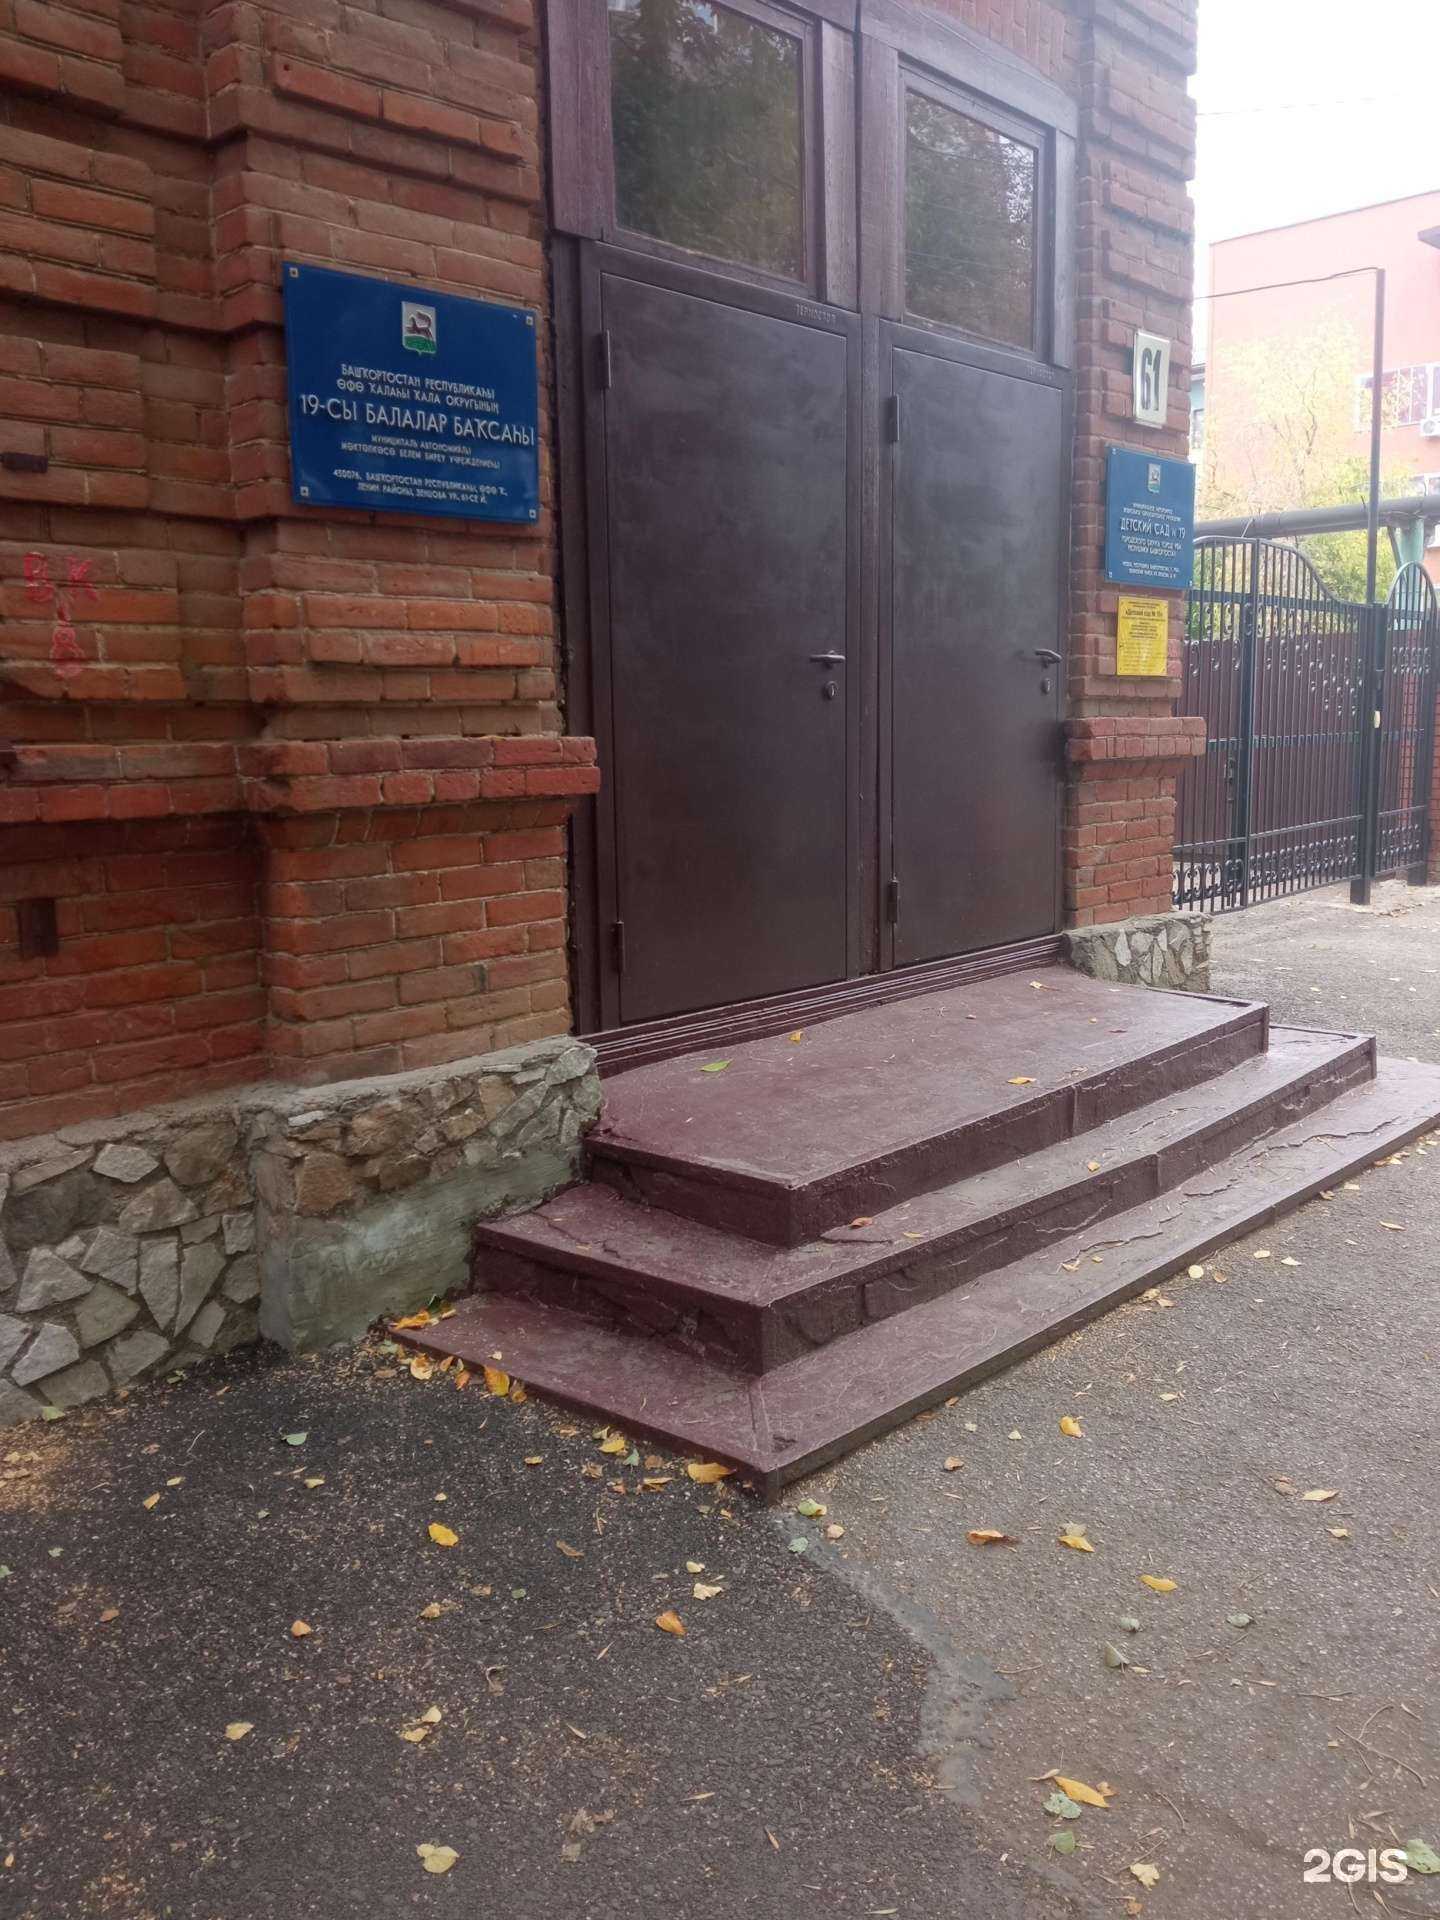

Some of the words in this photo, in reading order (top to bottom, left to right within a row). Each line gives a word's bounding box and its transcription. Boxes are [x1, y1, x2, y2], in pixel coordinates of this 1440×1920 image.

[336, 379, 365, 393] ӨФӨ
[413, 390, 441, 405] ҠАЛА
[1140, 347, 1163, 411] 61
[300, 394, 357, 422] 19-СЫ
[366, 404, 448, 434] БАЛАЛАР
[453, 416, 535, 446] БАҠСАҺЫ
[1120, 517, 1152, 535] ДЕТСКИЙ
[1154, 523, 1170, 537] САД
[1179, 527, 1186, 539] 19
